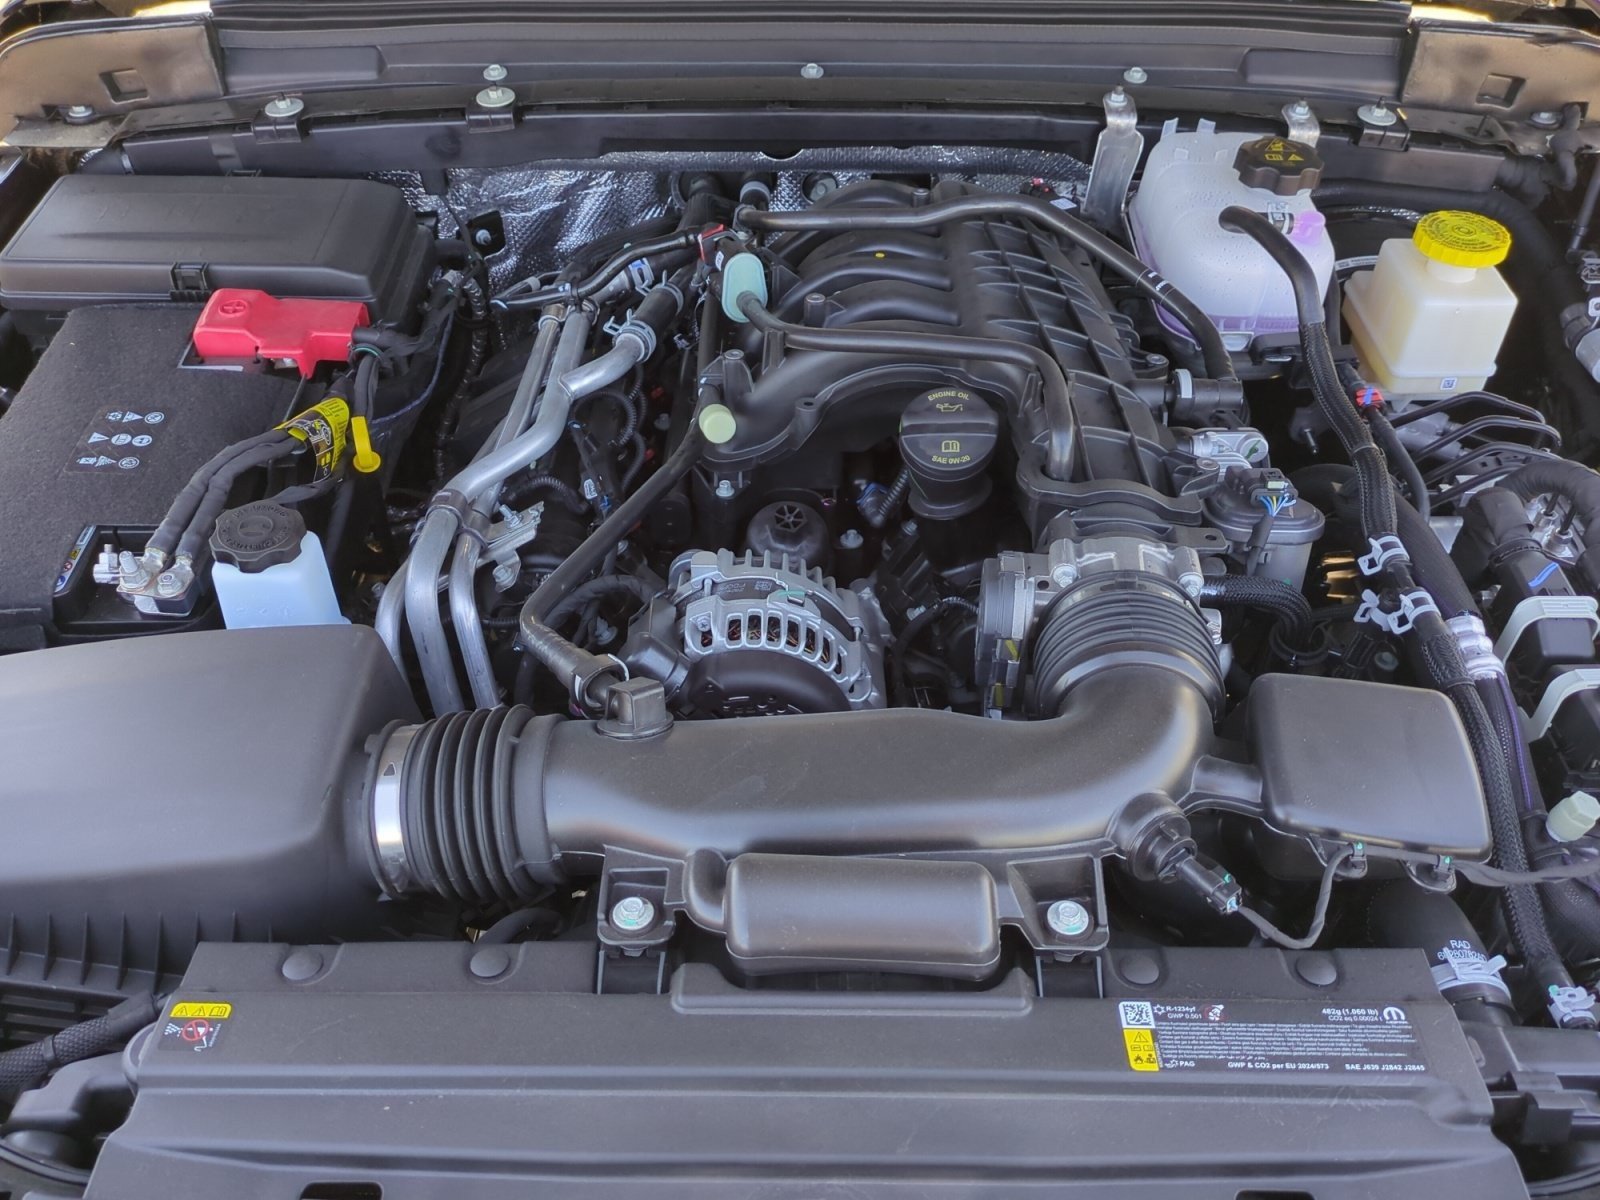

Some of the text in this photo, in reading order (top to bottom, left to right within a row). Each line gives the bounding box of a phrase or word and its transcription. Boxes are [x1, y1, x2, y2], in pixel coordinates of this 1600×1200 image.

[928, 391, 970, 402] ENGINE OIL
[931, 455, 971, 464] SAE 0W-20
[1449, 939, 1471, 949] RAD
